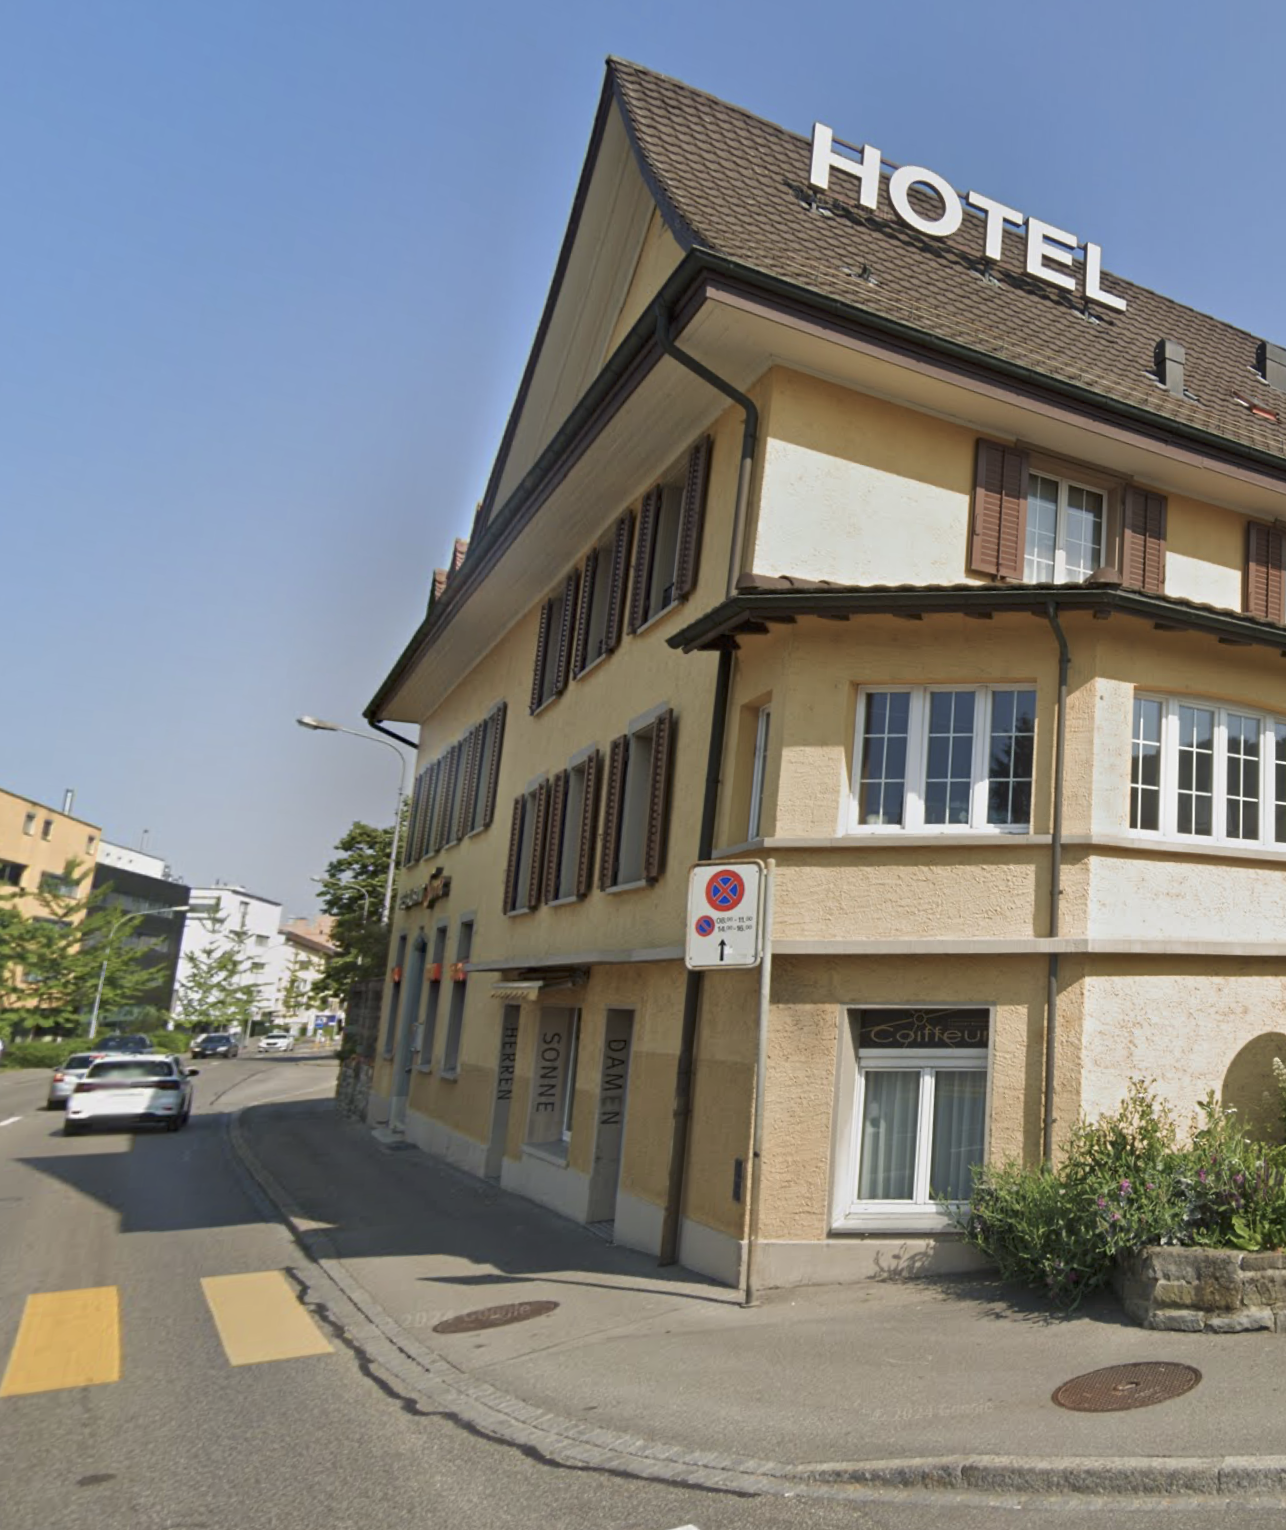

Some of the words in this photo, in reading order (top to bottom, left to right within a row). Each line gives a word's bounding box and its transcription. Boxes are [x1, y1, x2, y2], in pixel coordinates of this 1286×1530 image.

[810, 121, 1127, 313] HOTEL
[497, 1027, 518, 1100] HERREN
[536, 1032, 562, 1113] SONNE
[870, 1025, 989, 1043] Coiffeur
[600, 1039, 627, 1125] DAMEN
